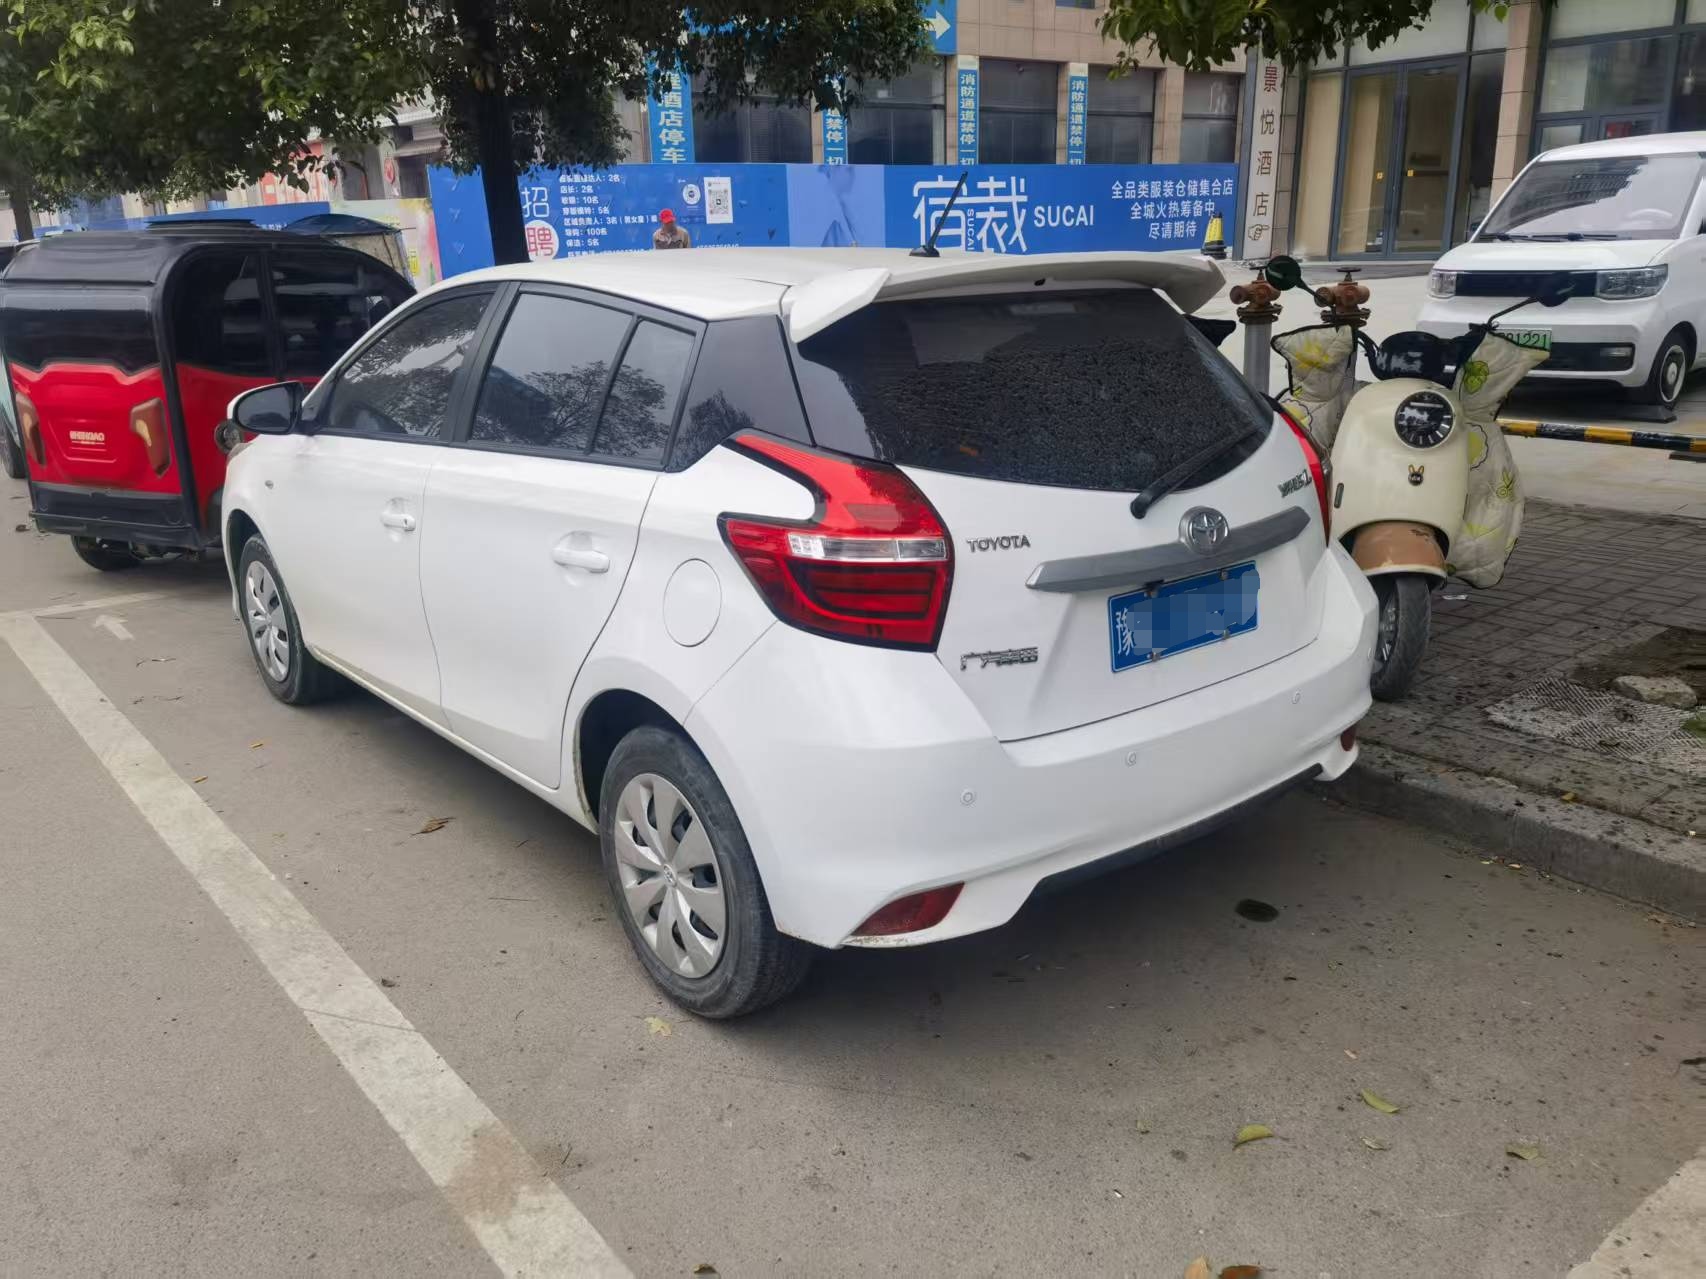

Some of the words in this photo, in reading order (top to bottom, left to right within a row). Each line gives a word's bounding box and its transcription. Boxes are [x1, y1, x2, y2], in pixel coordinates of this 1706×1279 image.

[1252, 65, 1277, 217] 景悦酒店
[1111, 178, 1234, 199] 全品类服装仓储集合店
[1033, 204, 1095, 228] SUCAI
[1130, 199, 1216, 219] 全城火热筹备中
[1148, 221, 1198, 239] 尽请期待
[967, 534, 1031, 553] TOYOTA
